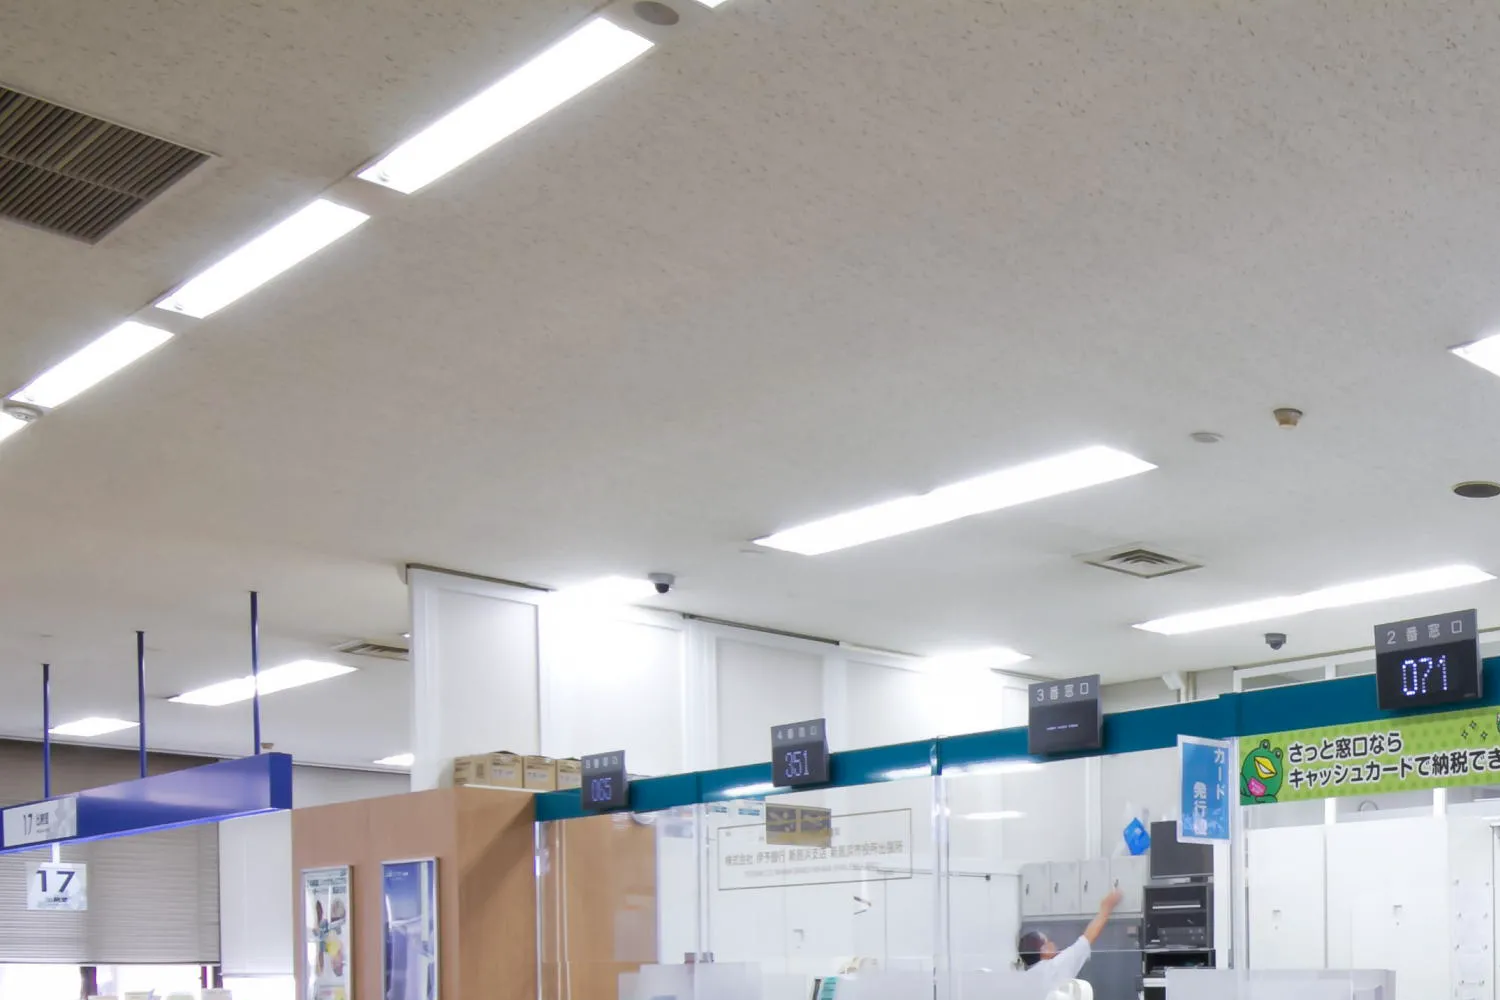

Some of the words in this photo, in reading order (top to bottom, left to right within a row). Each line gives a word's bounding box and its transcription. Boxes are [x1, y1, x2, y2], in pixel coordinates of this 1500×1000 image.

[1387, 620, 1462, 645] 2番窓口
[1401, 655, 1448, 696] 071
[1289, 732, 1403, 763] さっと窓口なら
[784, 750, 810, 778] 351
[1213, 748, 1226, 800] カード
[36, 870, 76, 893] 17
